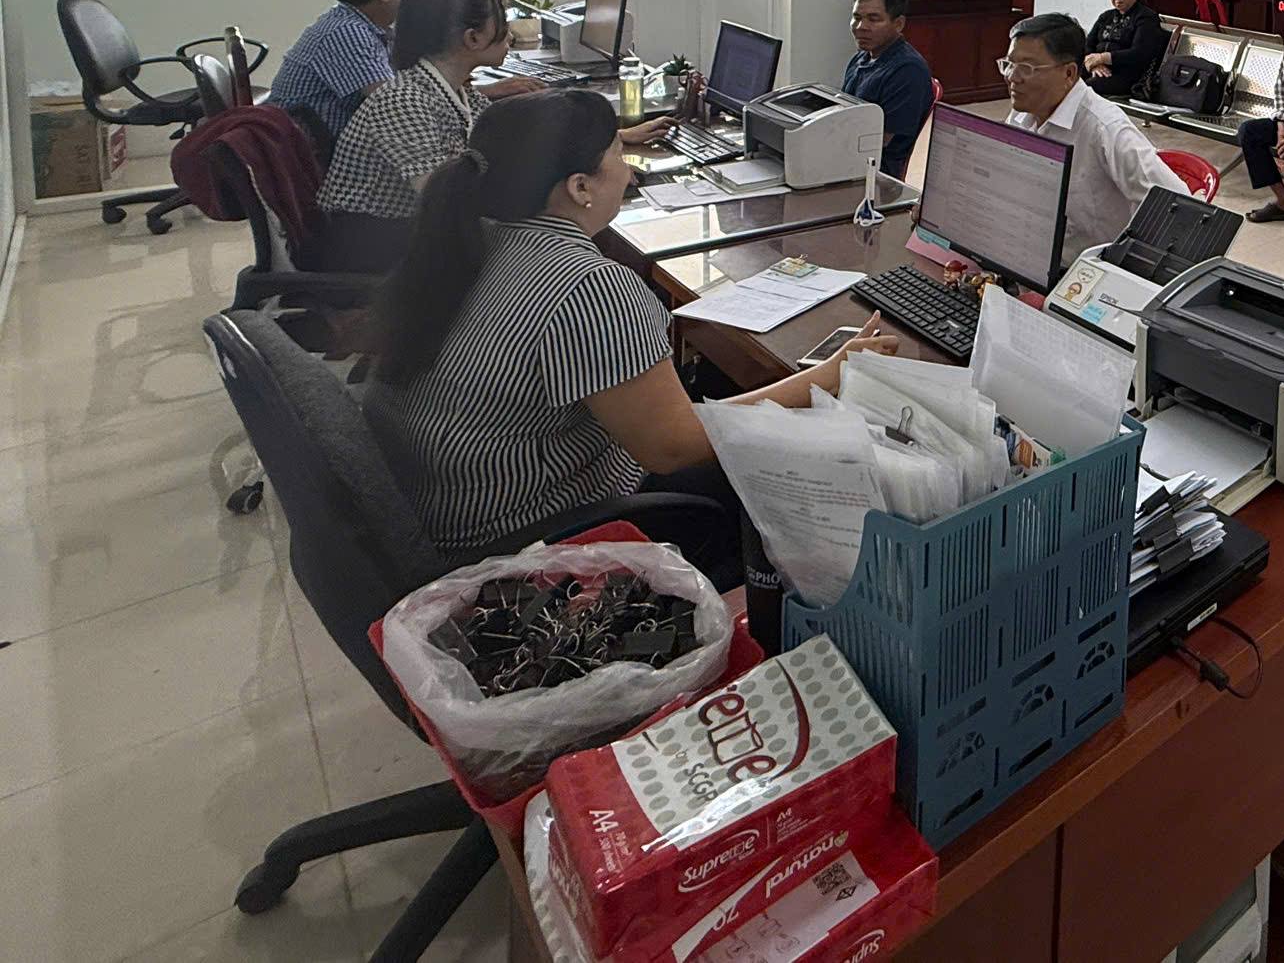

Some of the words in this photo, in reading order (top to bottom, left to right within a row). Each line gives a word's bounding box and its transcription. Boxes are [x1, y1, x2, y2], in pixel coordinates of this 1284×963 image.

[588, 810, 620, 833] A4
[683, 834, 756, 885] Supreme
[765, 836, 836, 898] natural
